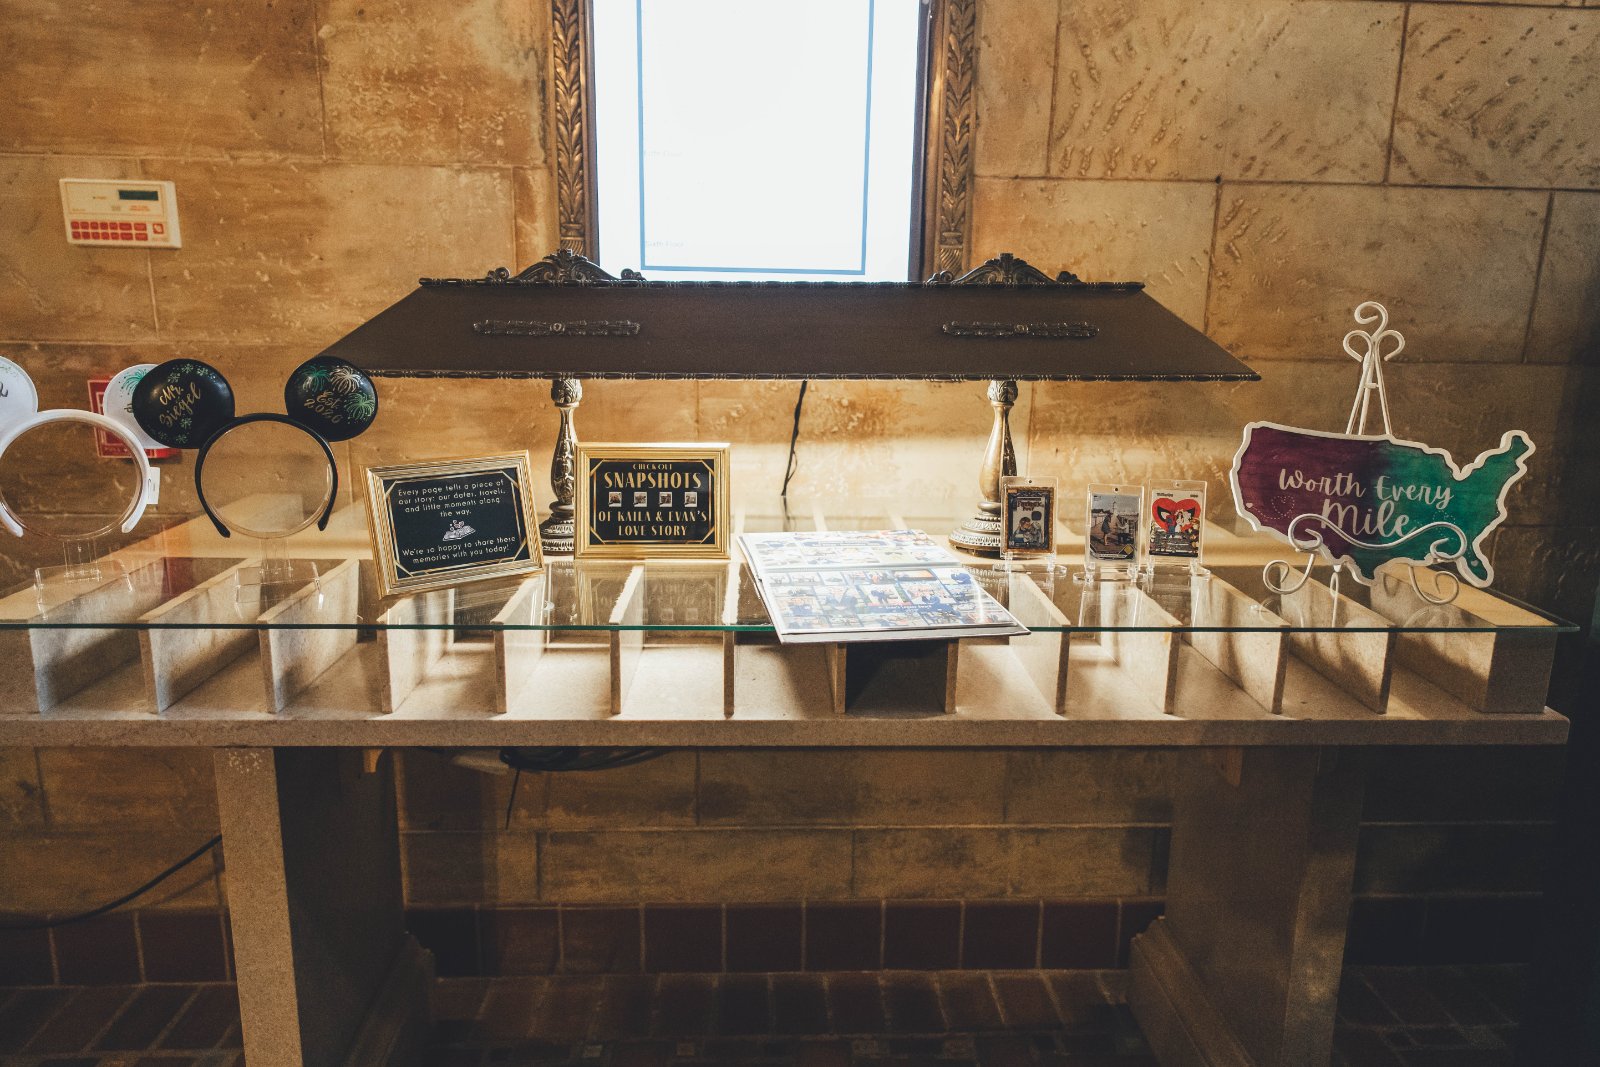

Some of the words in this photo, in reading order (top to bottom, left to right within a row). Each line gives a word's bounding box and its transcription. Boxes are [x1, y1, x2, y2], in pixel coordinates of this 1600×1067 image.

[159, 381, 201, 427] Siegel
[160, 384, 184, 406] Mr.
[304, 399, 344, 423] 2020
[398, 488, 419, 497] Every
[422, 486, 443, 496] page
[472, 480, 493, 490] piece
[496, 479, 504, 487] of
[604, 472, 702, 489] SNAPSHOTS
[1279, 469, 1366, 498] Worth
[1374, 475, 1454, 510] Every
[423, 503, 441, 511] little
[445, 499, 477, 509] moments
[479, 497, 500, 505] along
[456, 509, 472, 517] way.
[598, 510, 612, 521] OF
[618, 510, 651, 521] KAILA
[655, 511, 663, 521] &
[1321, 499, 1417, 538] Mile
[618, 525, 646, 536] LOVE
[651, 525, 687, 536] STORY
[402, 548, 424, 556] We're
[438, 544, 461, 553] happy
[475, 538, 494, 547] share
[413, 554, 449, 564] memories
[470, 549, 483, 557] you
